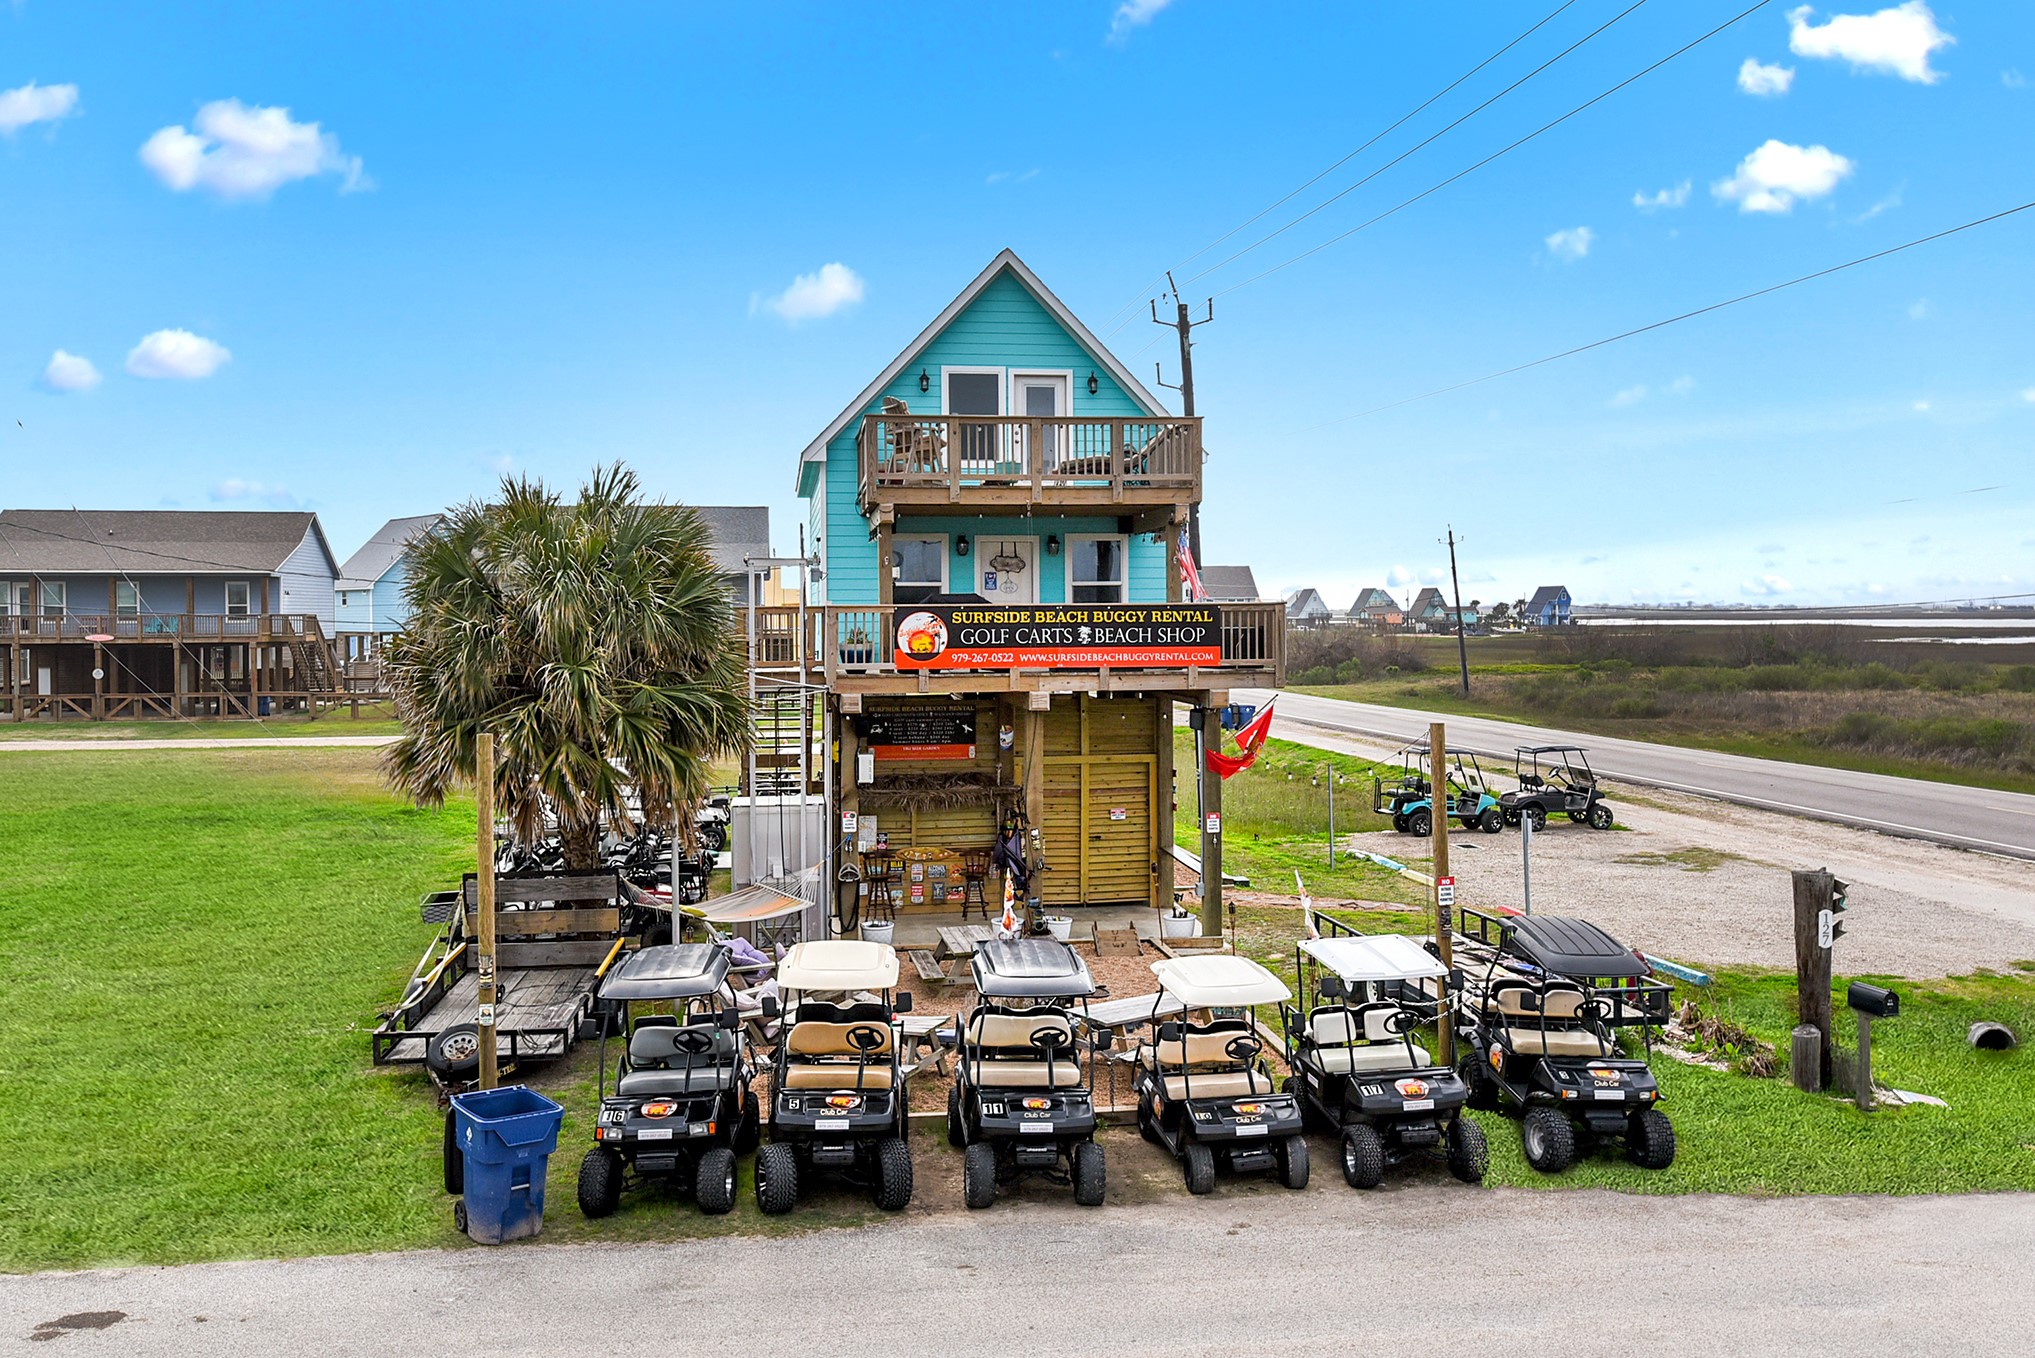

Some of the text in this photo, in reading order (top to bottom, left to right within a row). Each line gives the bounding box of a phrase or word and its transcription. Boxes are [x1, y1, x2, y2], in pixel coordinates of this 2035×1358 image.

[951, 610, 1213, 624] SURFSIDE BEACH BUGGY RENTAL
[960, 627, 1206, 645] GOLF CARTS BEACH SHOP
[951, 652, 1214, 663] 979-267-0522 WWW.SURFSIDEBEACHBUGGYRENTAL.COM
[1822, 913, 1830, 945] 127
[1363, 1085, 1381, 1096] 17
[789, 1099, 798, 1109] 5
[984, 1103, 1002, 1114] 11
[820, 1108, 848, 1116] Club Car
[1235, 1115, 1262, 1124] Club Car
